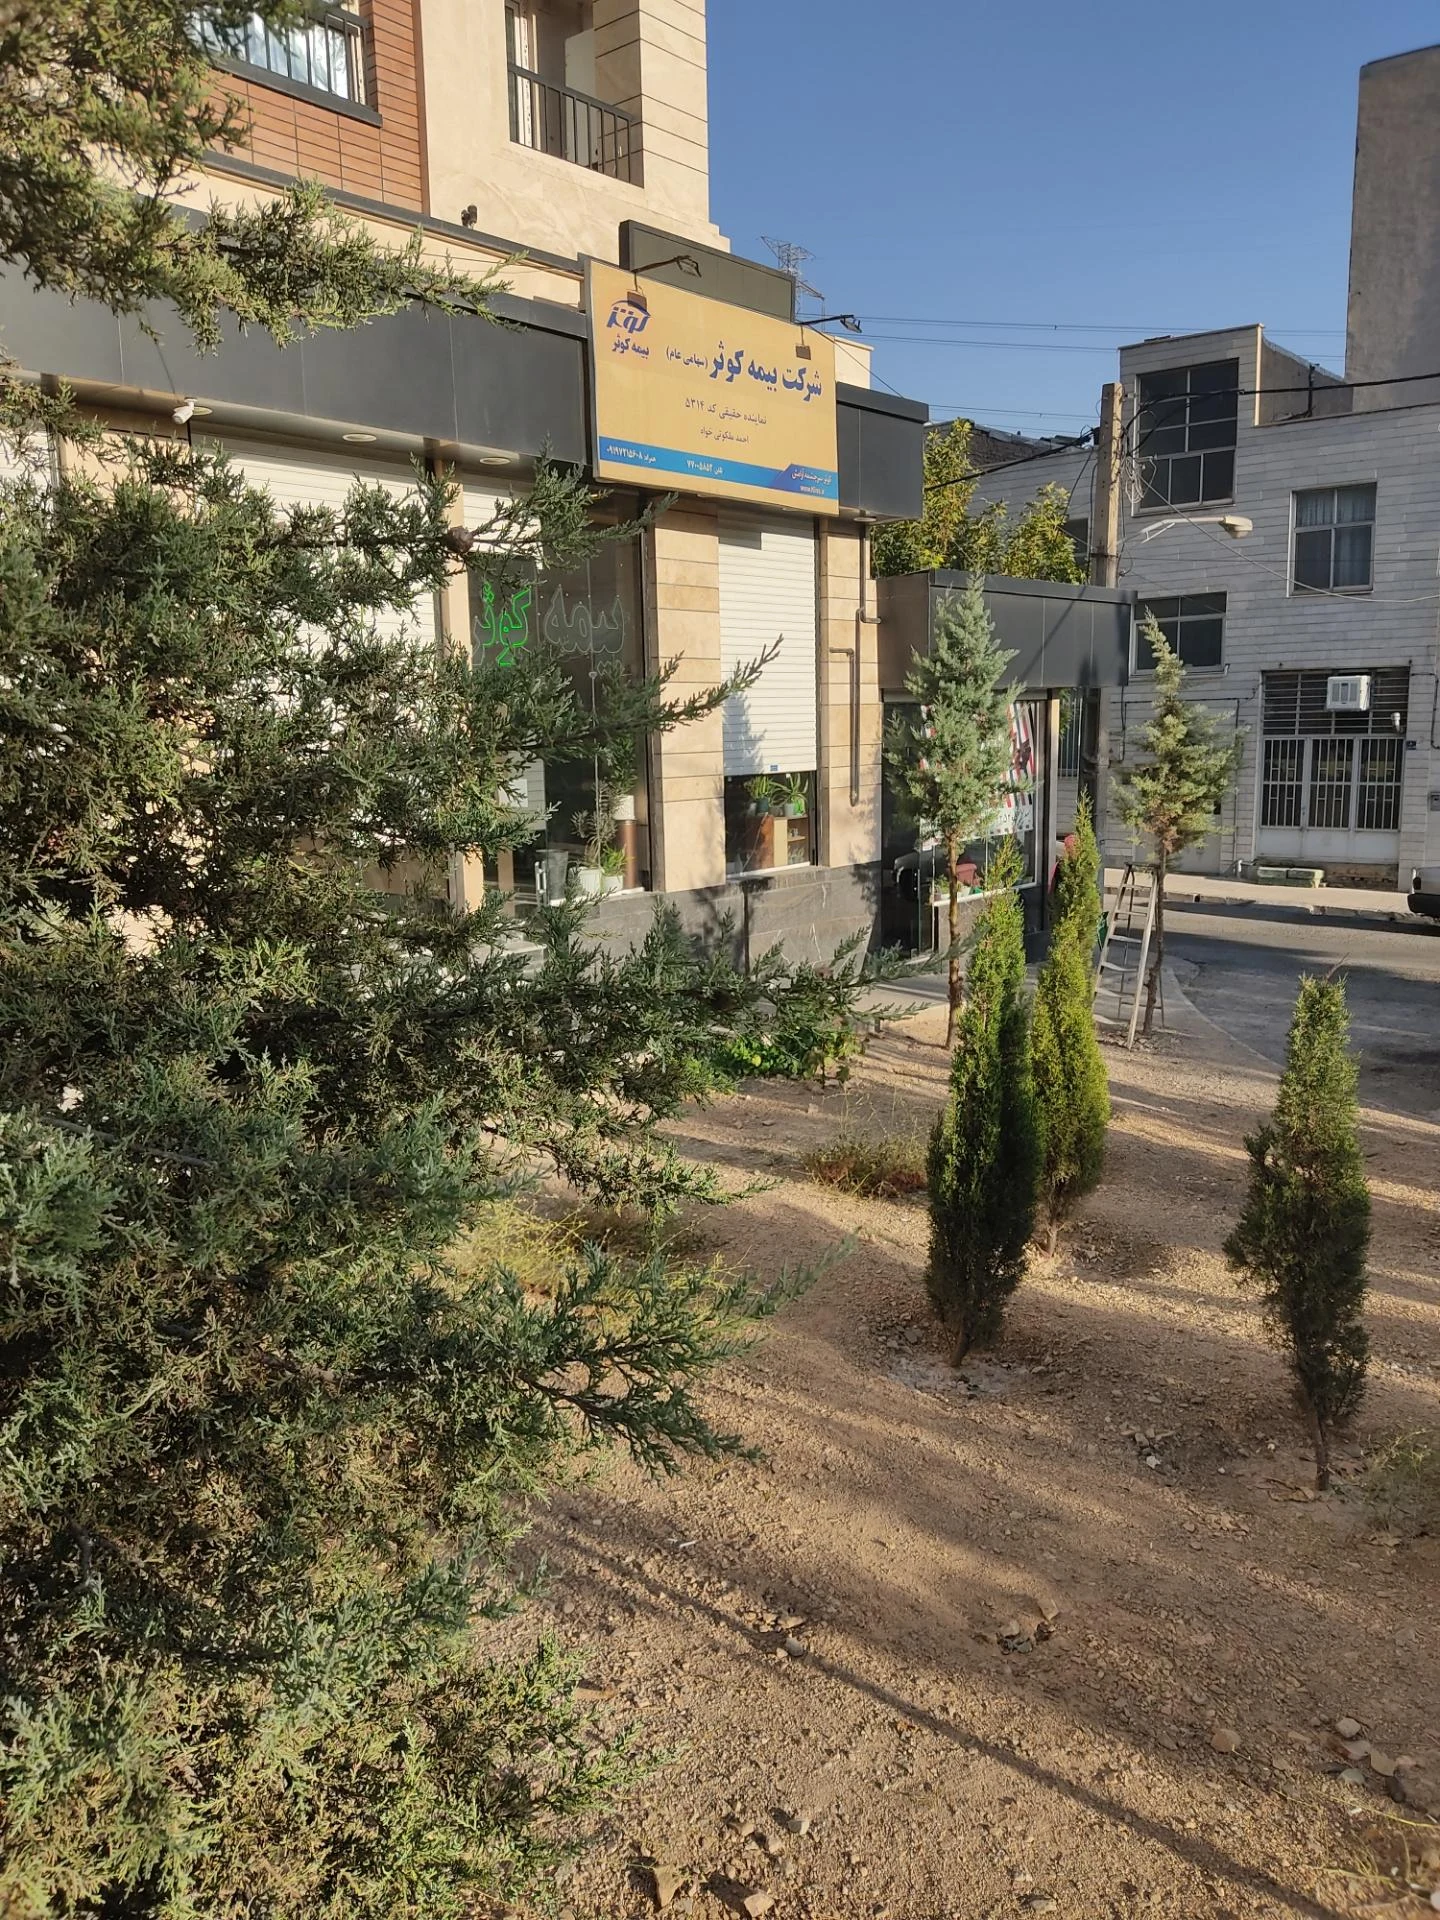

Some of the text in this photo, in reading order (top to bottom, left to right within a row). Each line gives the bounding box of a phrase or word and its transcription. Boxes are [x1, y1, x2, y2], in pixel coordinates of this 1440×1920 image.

[612, 333, 650, 359] بیمه کوثر
[666, 345, 682, 360] عام)
[709, 340, 744, 382] کوثر
[748, 360, 778, 392] بیمه
[782, 367, 822, 401] شرکت
[685, 397, 766, 425] نماینده حقیقی کد ۵۳۱۴
[736, 435, 750, 444] احمد
